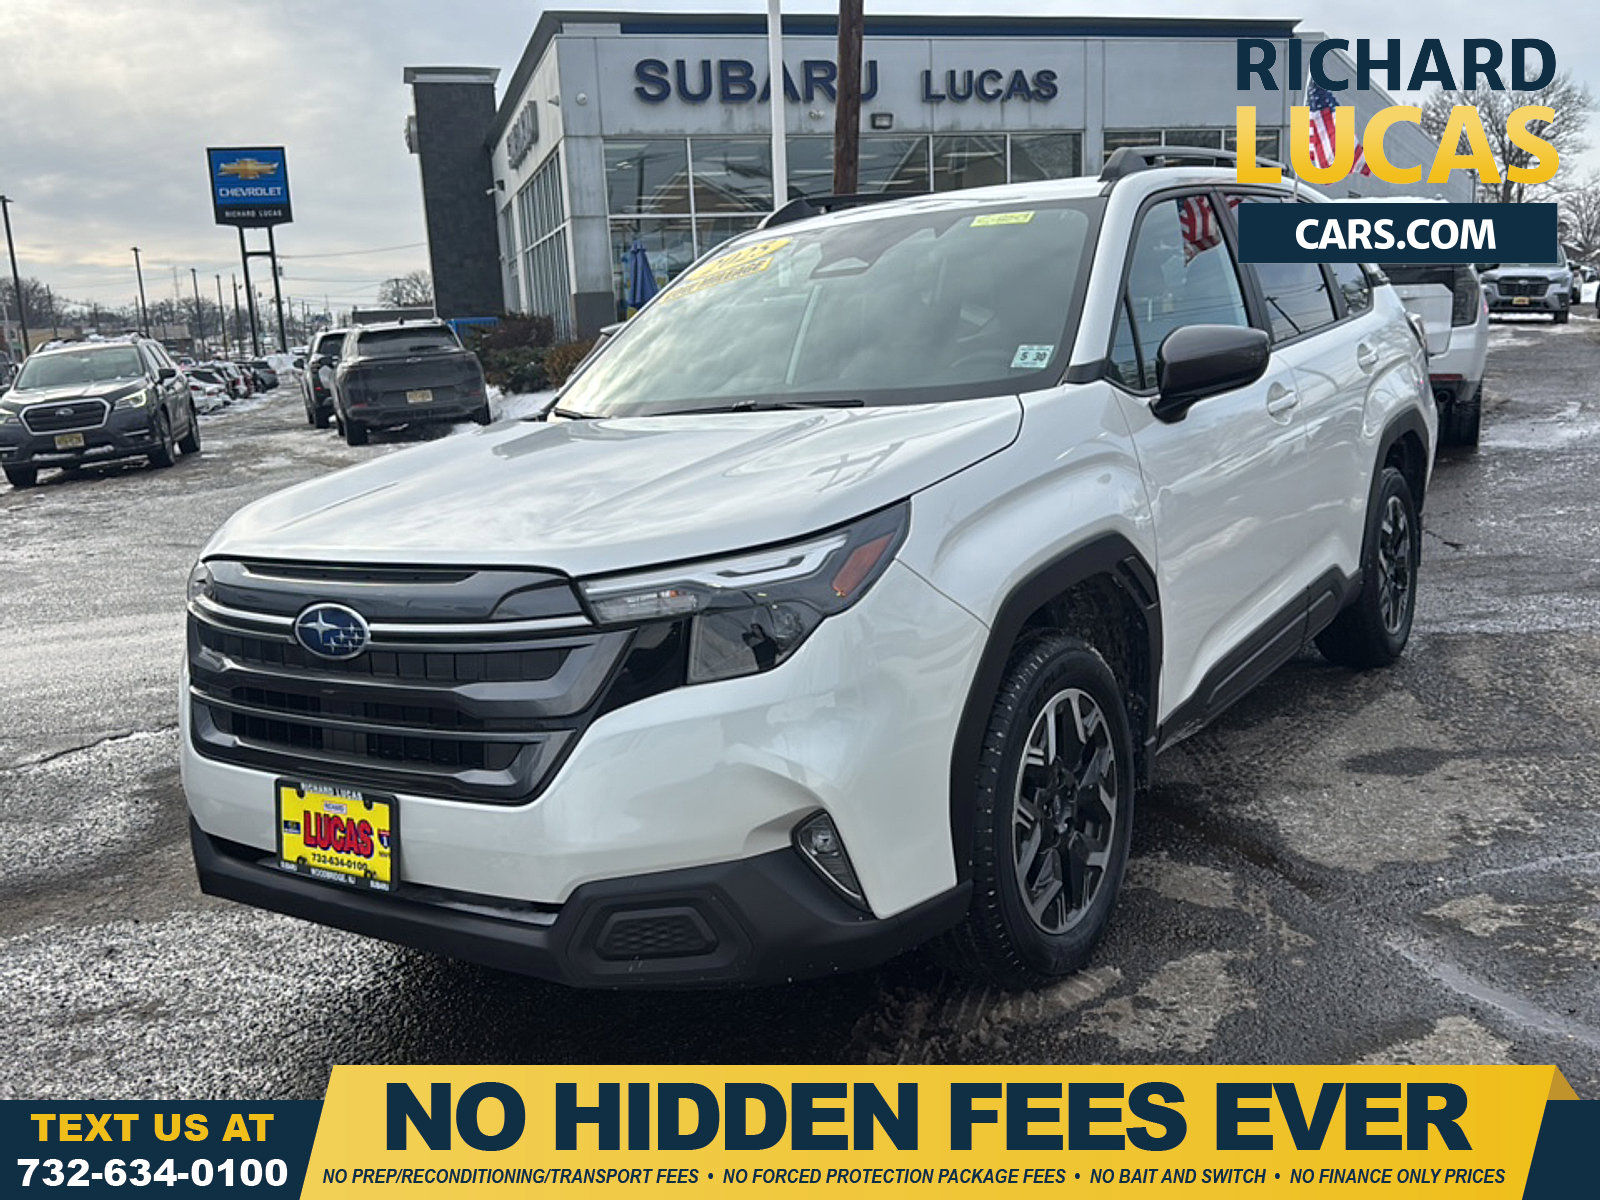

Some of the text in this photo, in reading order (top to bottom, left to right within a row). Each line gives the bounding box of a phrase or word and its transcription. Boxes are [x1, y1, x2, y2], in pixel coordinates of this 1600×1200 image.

[921, 69, 1058, 103] LUCAS
[218, 186, 283, 198] CHEVROLET
[224, 209, 283, 218] RICHARD LUCAS
[301, 782, 363, 801] RICHARD LUCAS
[303, 810, 375, 859] LUCAS
[311, 853, 368, 871] 732-634-0100
